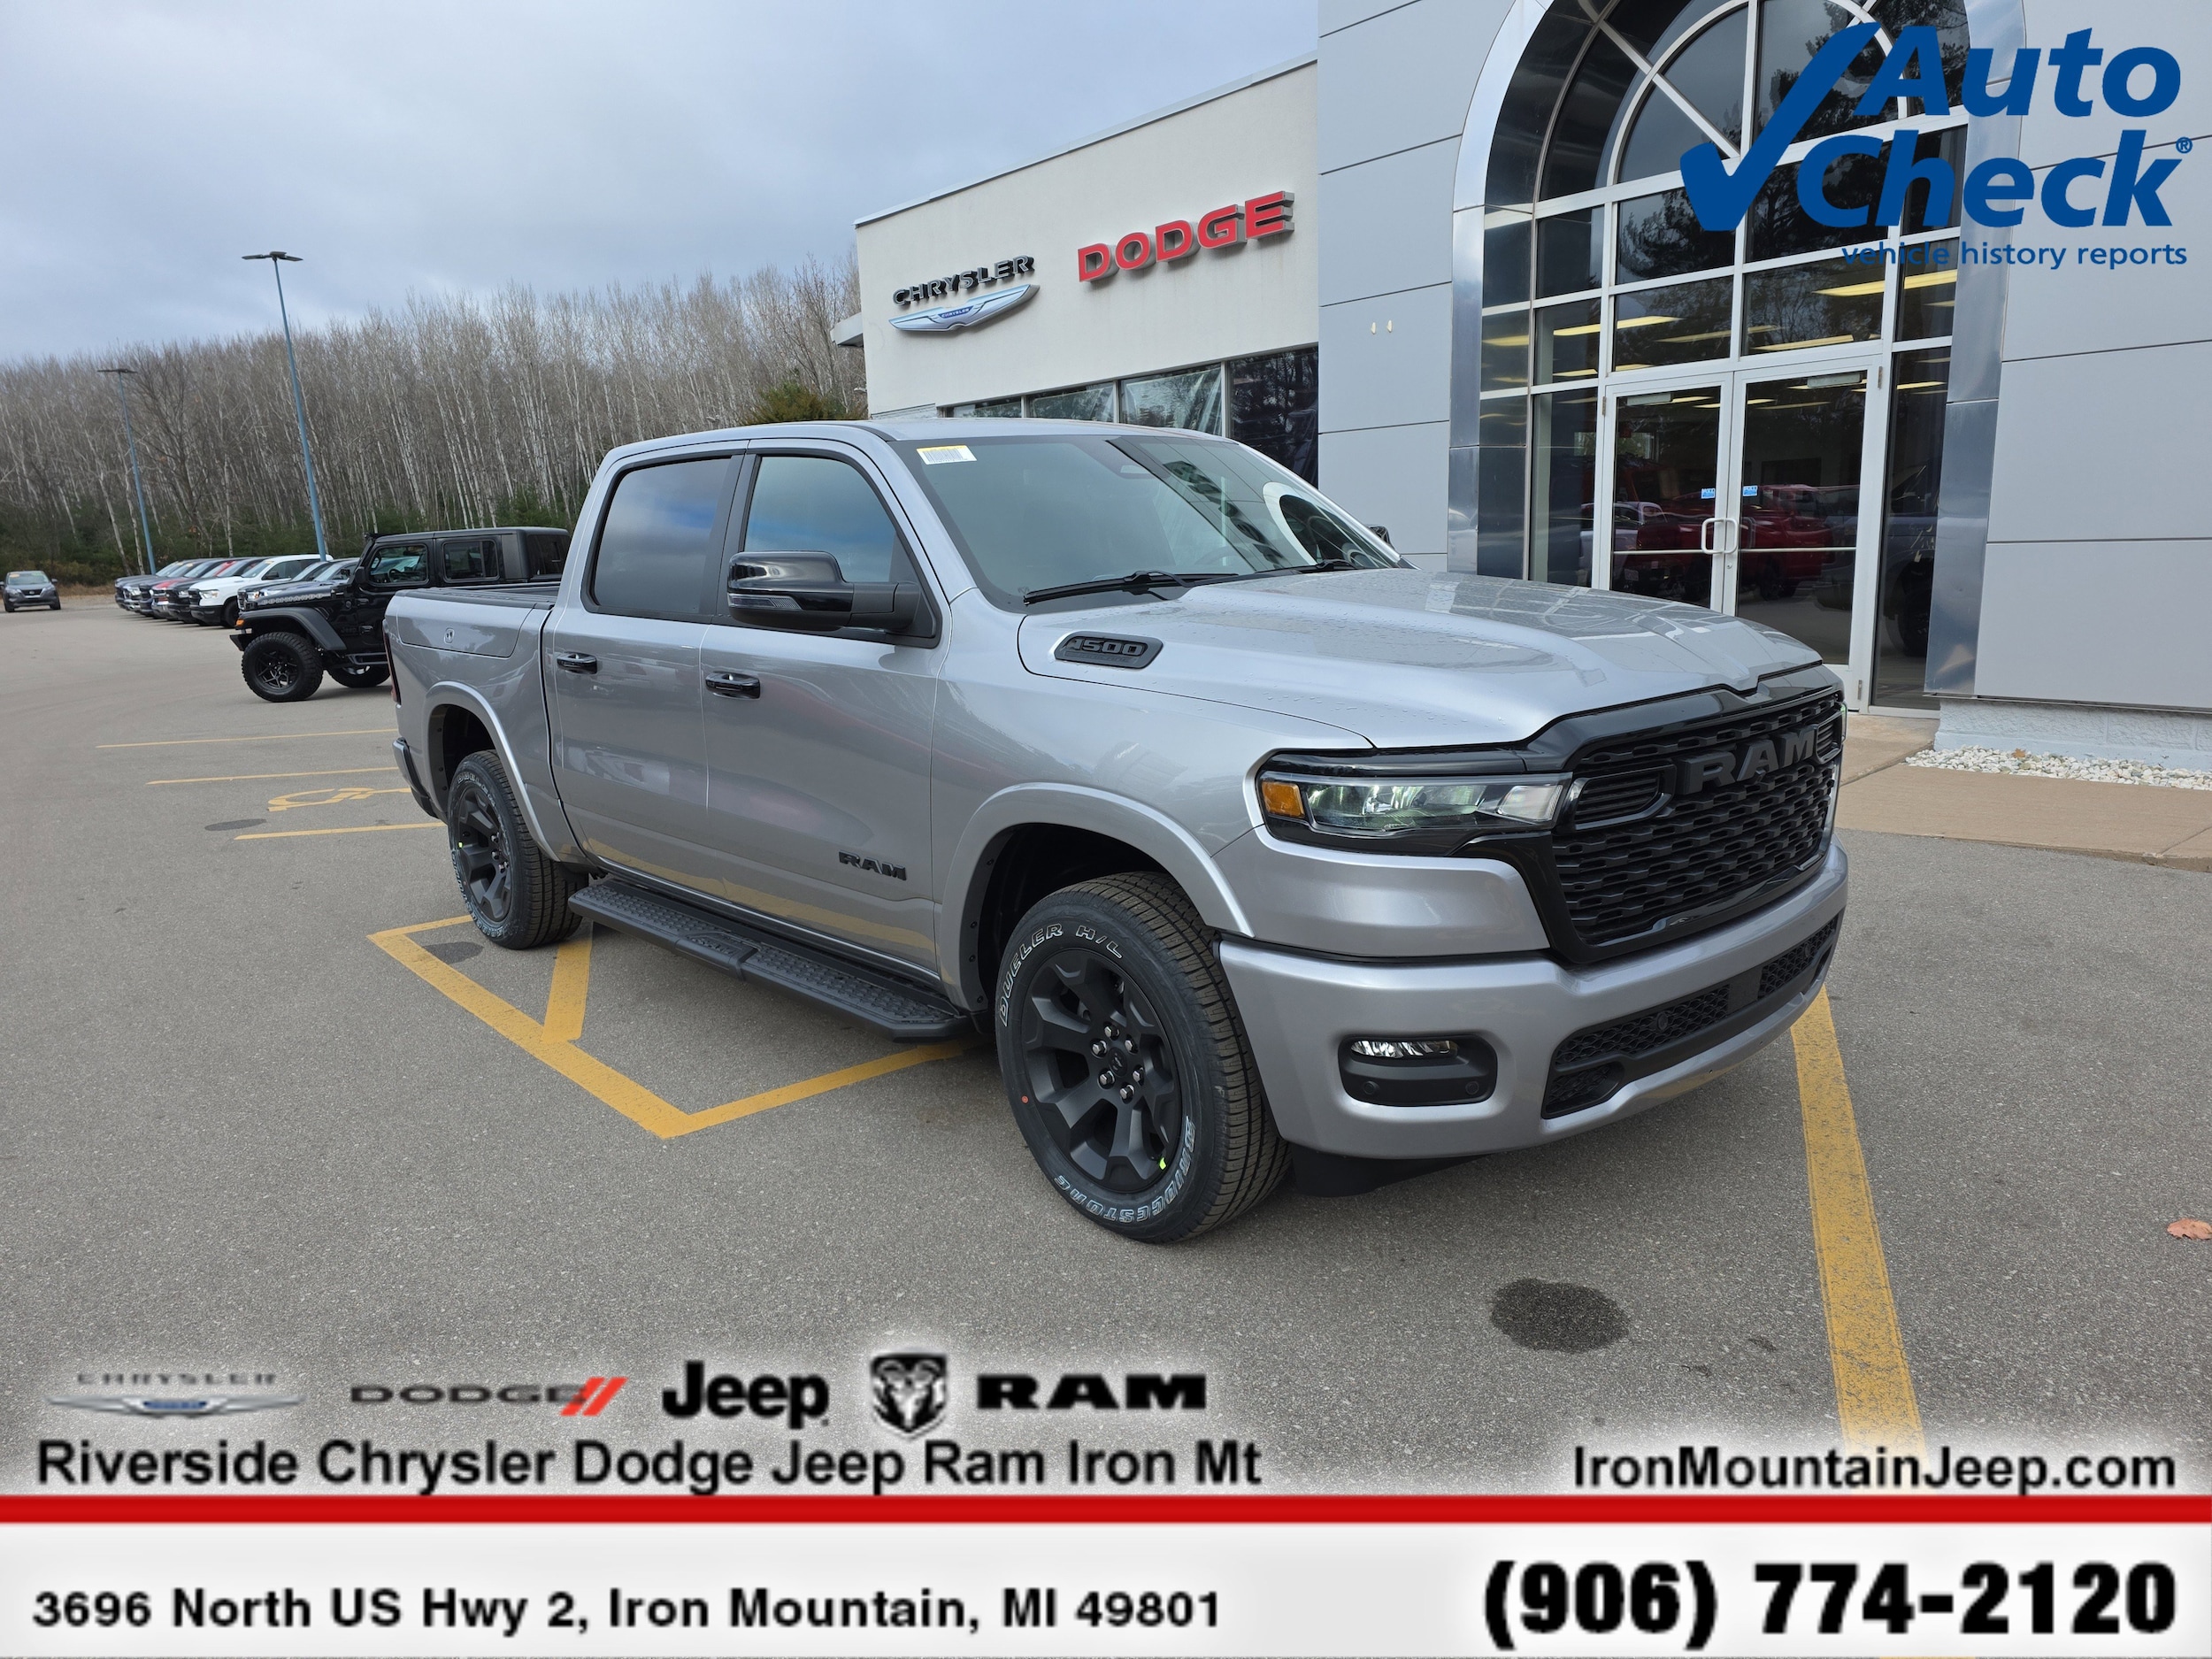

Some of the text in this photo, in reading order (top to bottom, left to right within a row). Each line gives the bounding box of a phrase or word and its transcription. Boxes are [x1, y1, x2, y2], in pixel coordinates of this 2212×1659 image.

[1078, 190, 1294, 284] DODGE
[893, 255, 1034, 307] CHRYSLER
[941, 307, 971, 318] CHRYSLER
[1065, 637, 1145, 657] 1500
[1675, 726, 1817, 795] RAM
[839, 849, 907, 881] RAM
[996, 922, 1064, 1027] DUELER
[1054, 1114, 1197, 1224] BRIDGESTONE
